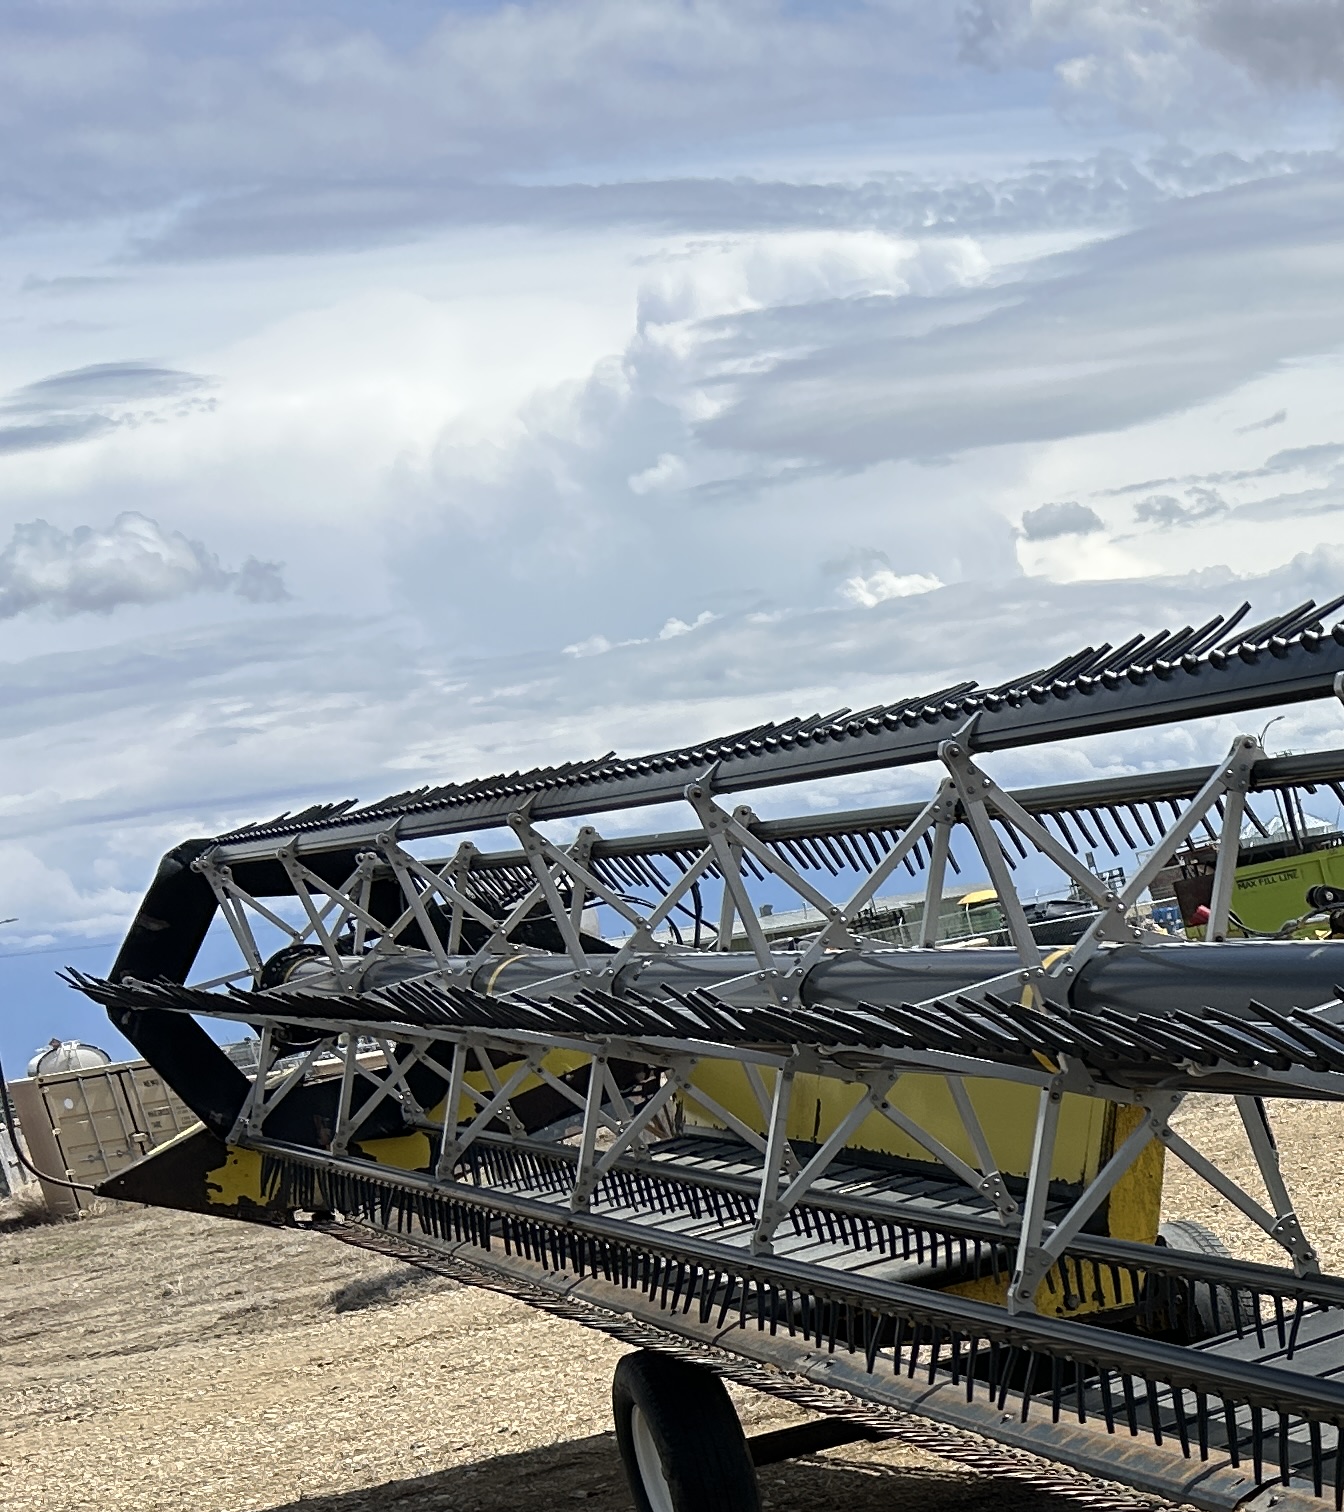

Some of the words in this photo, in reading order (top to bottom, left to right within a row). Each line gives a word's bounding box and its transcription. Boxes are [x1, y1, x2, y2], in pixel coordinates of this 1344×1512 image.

[1237, 880, 1258, 890] MAX
[1259, 876, 1278, 886] FILL
[1279, 871, 1300, 882] LINE
